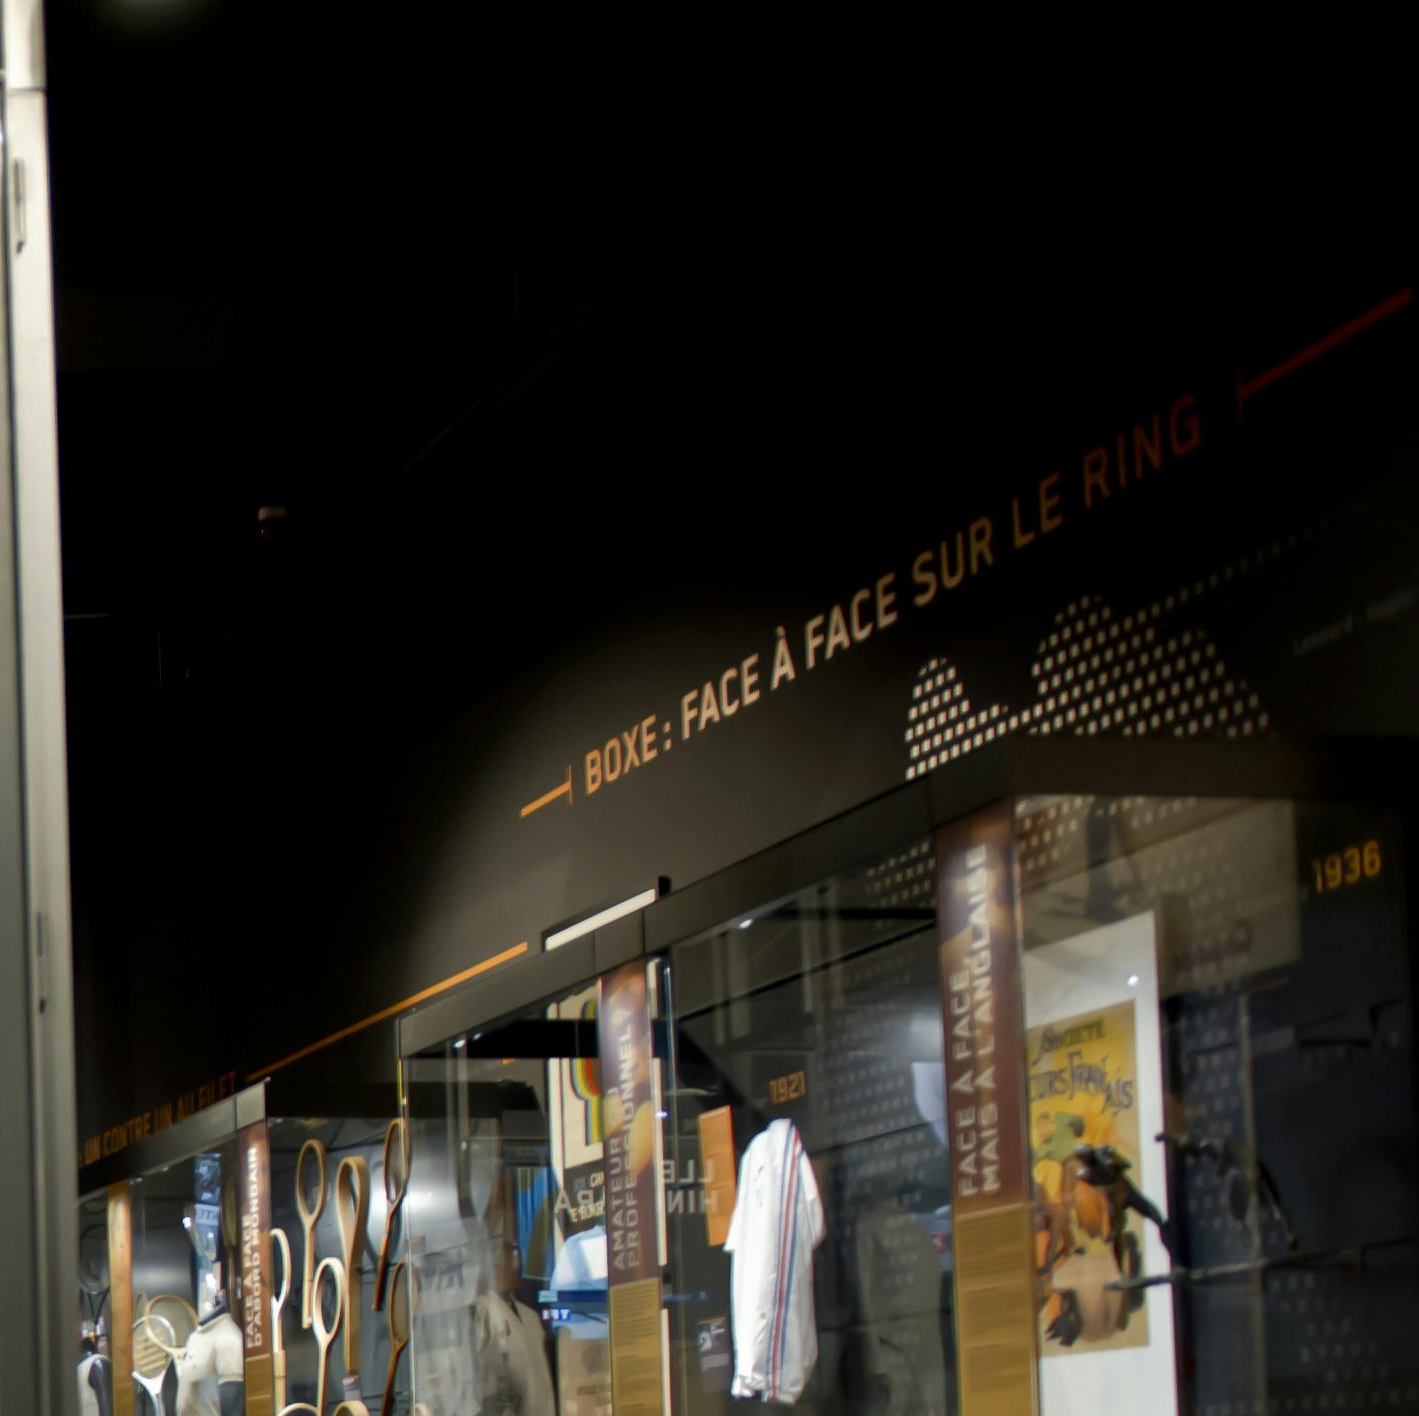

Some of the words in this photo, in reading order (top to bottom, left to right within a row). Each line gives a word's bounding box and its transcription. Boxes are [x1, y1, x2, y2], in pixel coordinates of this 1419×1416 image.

[680, 653, 762, 741] FACE
[769, 625, 796, 692] À
[804, 571, 900, 670] FACE
[911, 513, 996, 609] SUR
[1009, 471, 1065, 552] LE
[1080, 389, 1204, 510] RING
[1311, 837, 1384, 893] 1936
[967, 843, 995, 1059] L'ANGLAISE
[609, 1134, 628, 1271] AMATEUR
[619, 1025, 640, 1268] PROFESSIONNEL
[956, 1103, 980, 1198] FACE
[977, 1102, 1001, 1194] MAIS
